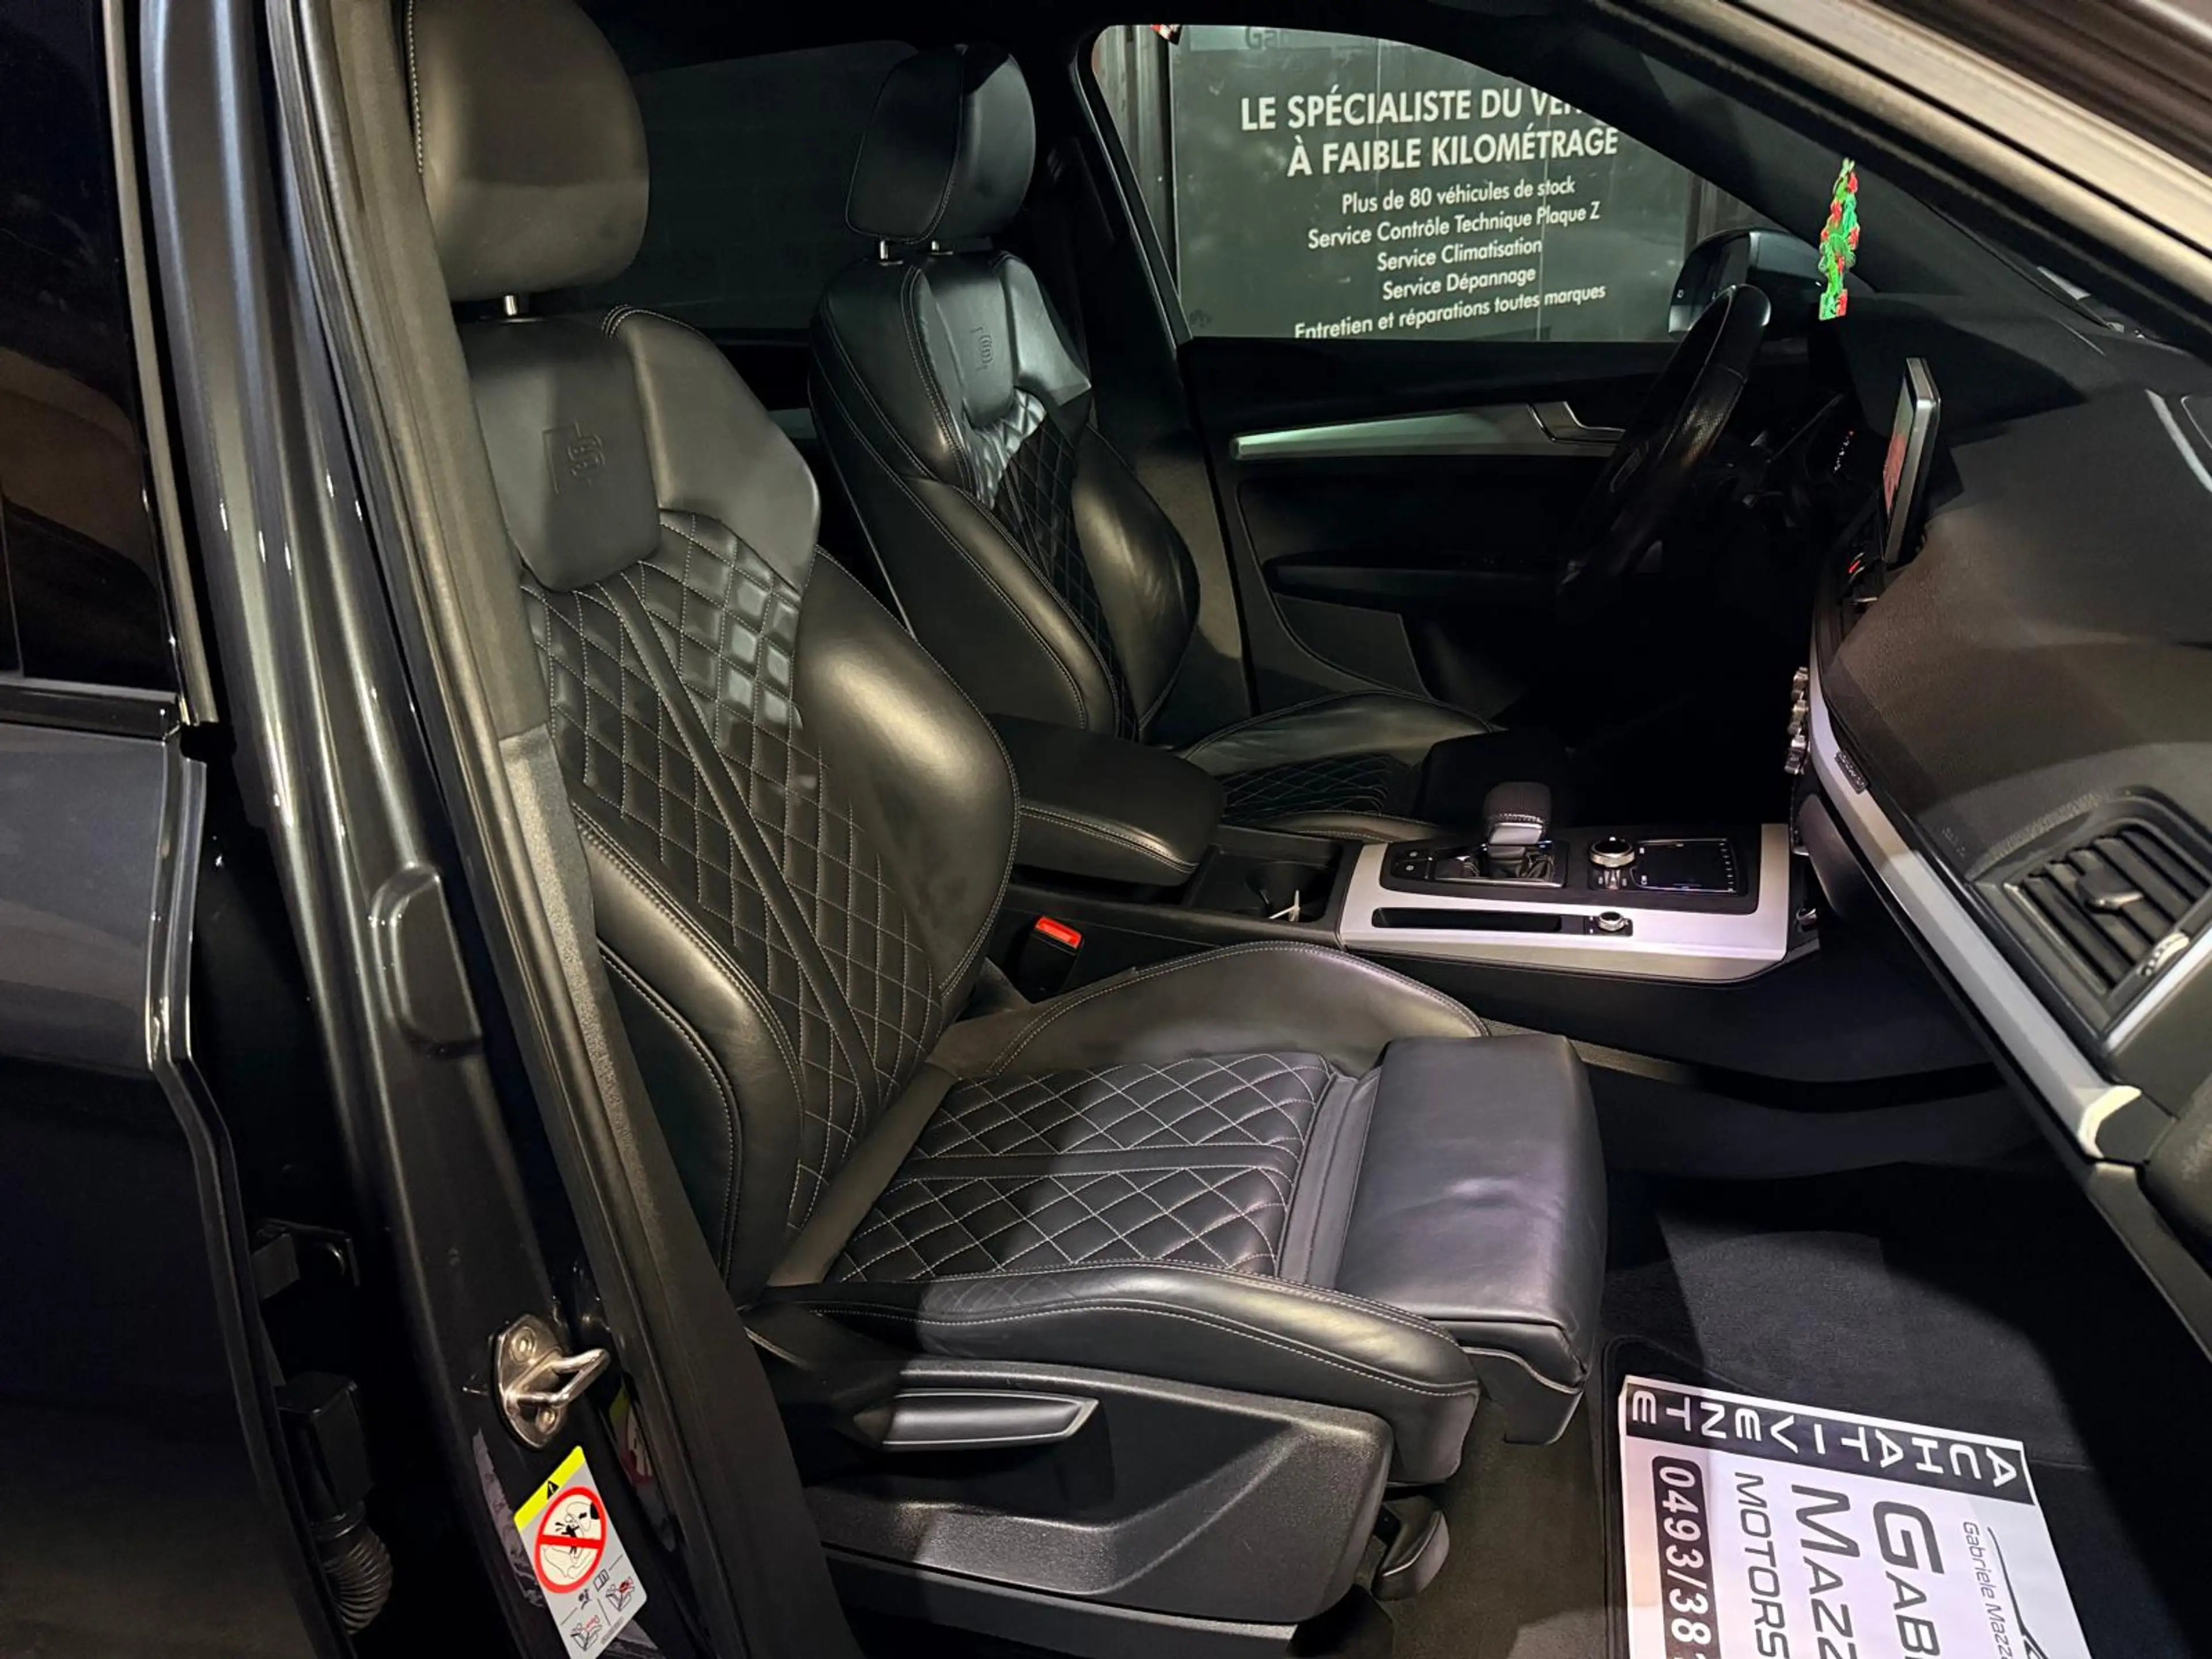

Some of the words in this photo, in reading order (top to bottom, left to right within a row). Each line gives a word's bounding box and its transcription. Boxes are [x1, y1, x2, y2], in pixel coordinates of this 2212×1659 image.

[1241, 96, 1276, 131] LE
[1287, 84, 1471, 128] SPÉCIALISTE
[1481, 88, 1522, 119] DU
[1287, 134, 1313, 177] À
[1323, 138, 1421, 175] FAIBLE
[1431, 122, 1619, 166] KILOMÉTRAGE
[1342, 191, 1378, 214] Plus
[1382, 189, 1404, 211] de
[1410, 187, 1432, 208] 80
[1437, 181, 1510, 205] véhicules
[1514, 178, 1533, 199] de
[1537, 175, 1575, 196] stock
[1308, 225, 1372, 249] Service
[1377, 215, 1450, 241] Contrôle
[1454, 210, 1532, 233] Technique
[1536, 205, 1586, 228] Plaque
[1590, 201, 1600, 220] Z
[1377, 248, 1437, 271] Service
[1441, 237, 1542, 263] Climatisation
[1382, 276, 1442, 300] Service
[1446, 268, 1536, 294] Dépannage
[1294, 316, 1373, 339] Entretien
[1378, 312, 1395, 330] et
[1399, 300, 1490, 329] réparations
[1494, 294, 1540, 313] toutes
[1544, 286, 1606, 306] marques
[1658, 1466, 1711, 1659] 0493/38
[1734, 1471, 1790, 1659] MOTORS
[1873, 1501, 1945, 1659] GAB
[1963, 1521, 1997, 1600] Gabriele
[1985, 1602, 2014, 1659] Mazz
